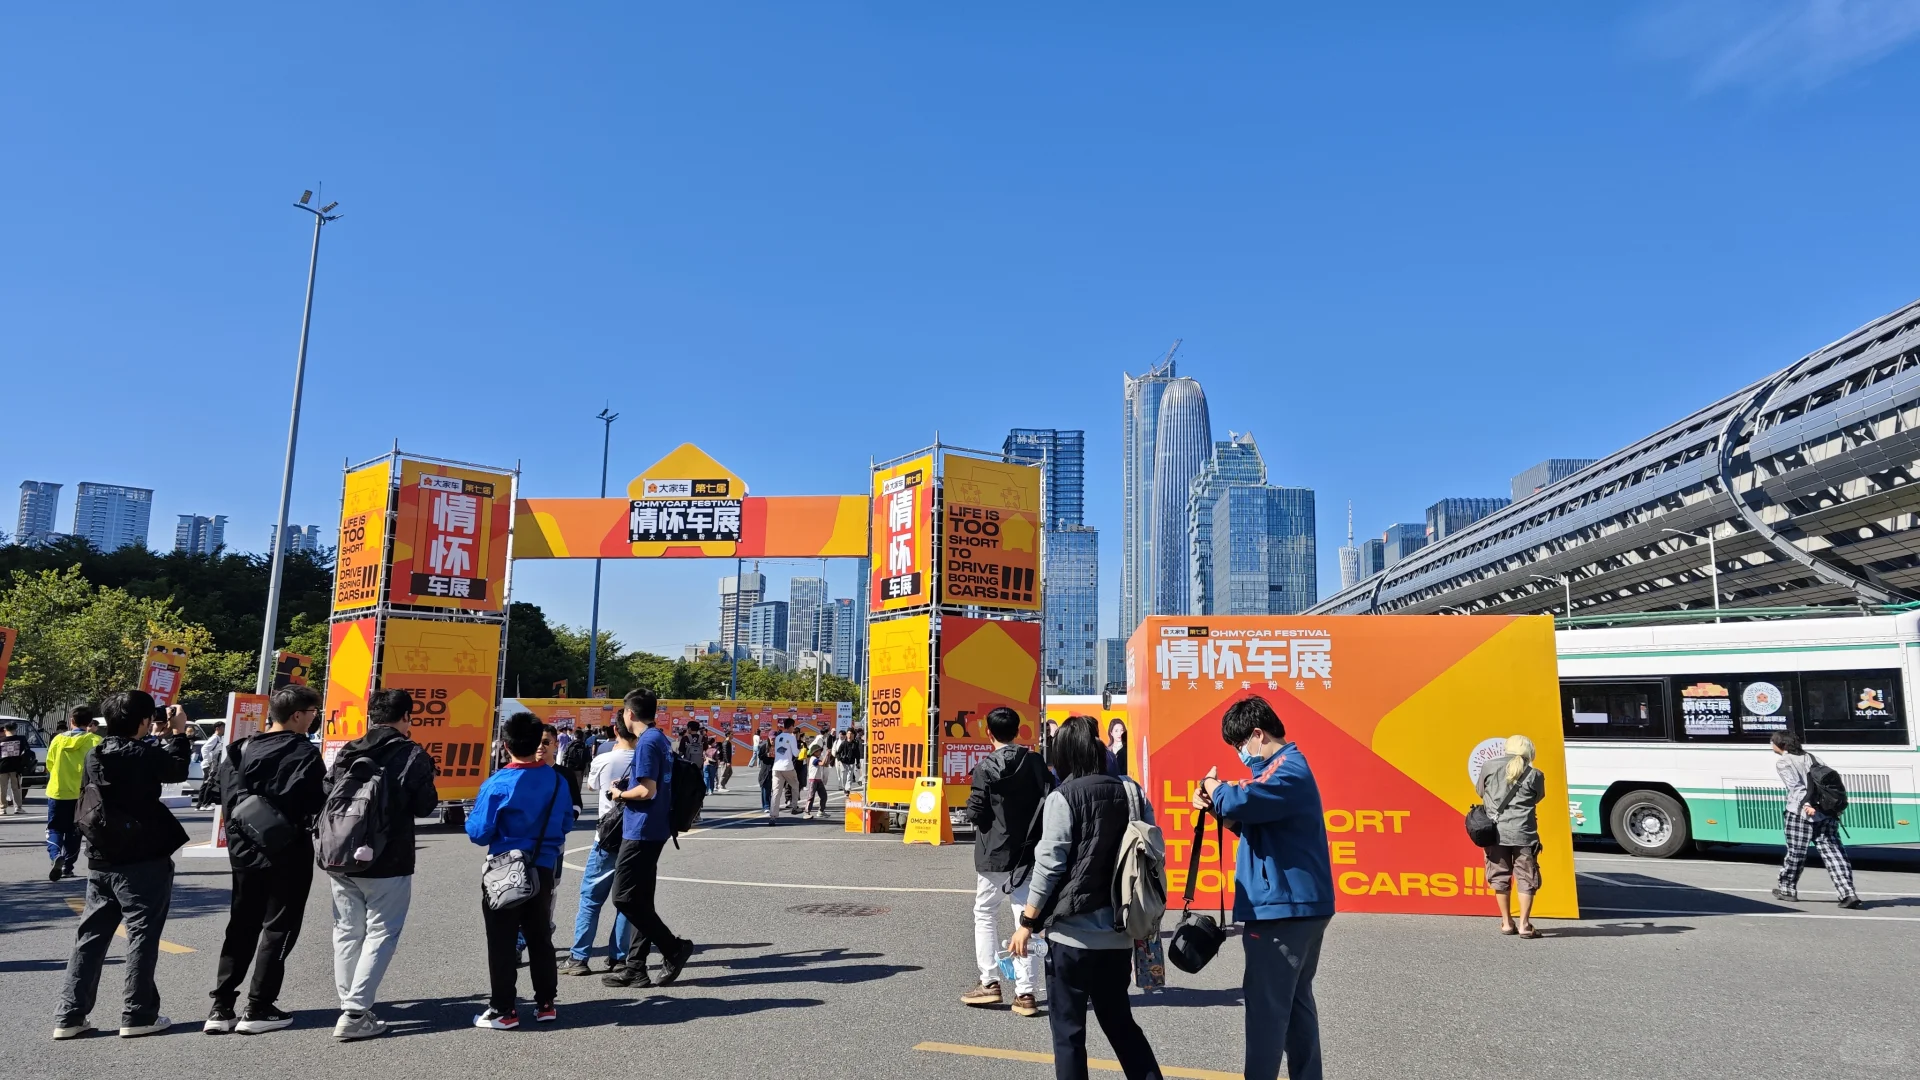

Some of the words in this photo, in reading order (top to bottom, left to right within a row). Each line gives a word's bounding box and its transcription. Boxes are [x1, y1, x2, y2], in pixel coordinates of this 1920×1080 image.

[433, 479, 459, 490] 大家车
[659, 484, 688, 493] 大家车
[695, 483, 727, 494] 第七届
[630, 506, 740, 534] 情怀车展
[949, 506, 982, 519] LIFE
[986, 510, 1000, 521] IS
[343, 518, 358, 529] LIFE
[359, 515, 366, 526] IS
[949, 518, 1000, 537] TOO
[343, 527, 365, 544] TOO
[429, 492, 477, 576] 情怀
[889, 490, 913, 576] 情怀
[949, 535, 999, 548] SHORT
[342, 543, 364, 555] SHORT
[949, 547, 972, 559] TO
[341, 557, 351, 567] TO
[948, 560, 999, 575] DRIVE
[340, 566, 362, 580] DRIVE
[948, 573, 999, 586] BORING
[339, 579, 361, 590] BORING
[427, 575, 471, 598] 车展
[889, 574, 912, 598] 车展
[338, 589, 360, 602] CARS
[948, 584, 999, 599] CARS
[1210, 629, 1272, 637] OHMYCAR
[1274, 629, 1331, 637] FESTIVAL
[1156, 638, 1332, 680] 情怀车展
[1161, 680, 1332, 690] 暨大家车粉丝节
[430, 689, 447, 699] IS
[872, 689, 890, 700] LIFE
[892, 688, 901, 699] IS
[411, 700, 446, 715] OO
[872, 700, 901, 716] TOO
[410, 717, 445, 727] ORT
[872, 718, 900, 728] SHORT
[1683, 714, 1715, 725] 11/22
[872, 731, 885, 740] TO
[872, 743, 901, 754] DRIVE
[872, 757, 901, 765] BORING
[872, 767, 901, 778] CARS
[1323, 809, 1411, 833] ORT
[1338, 871, 1459, 897] CARS
